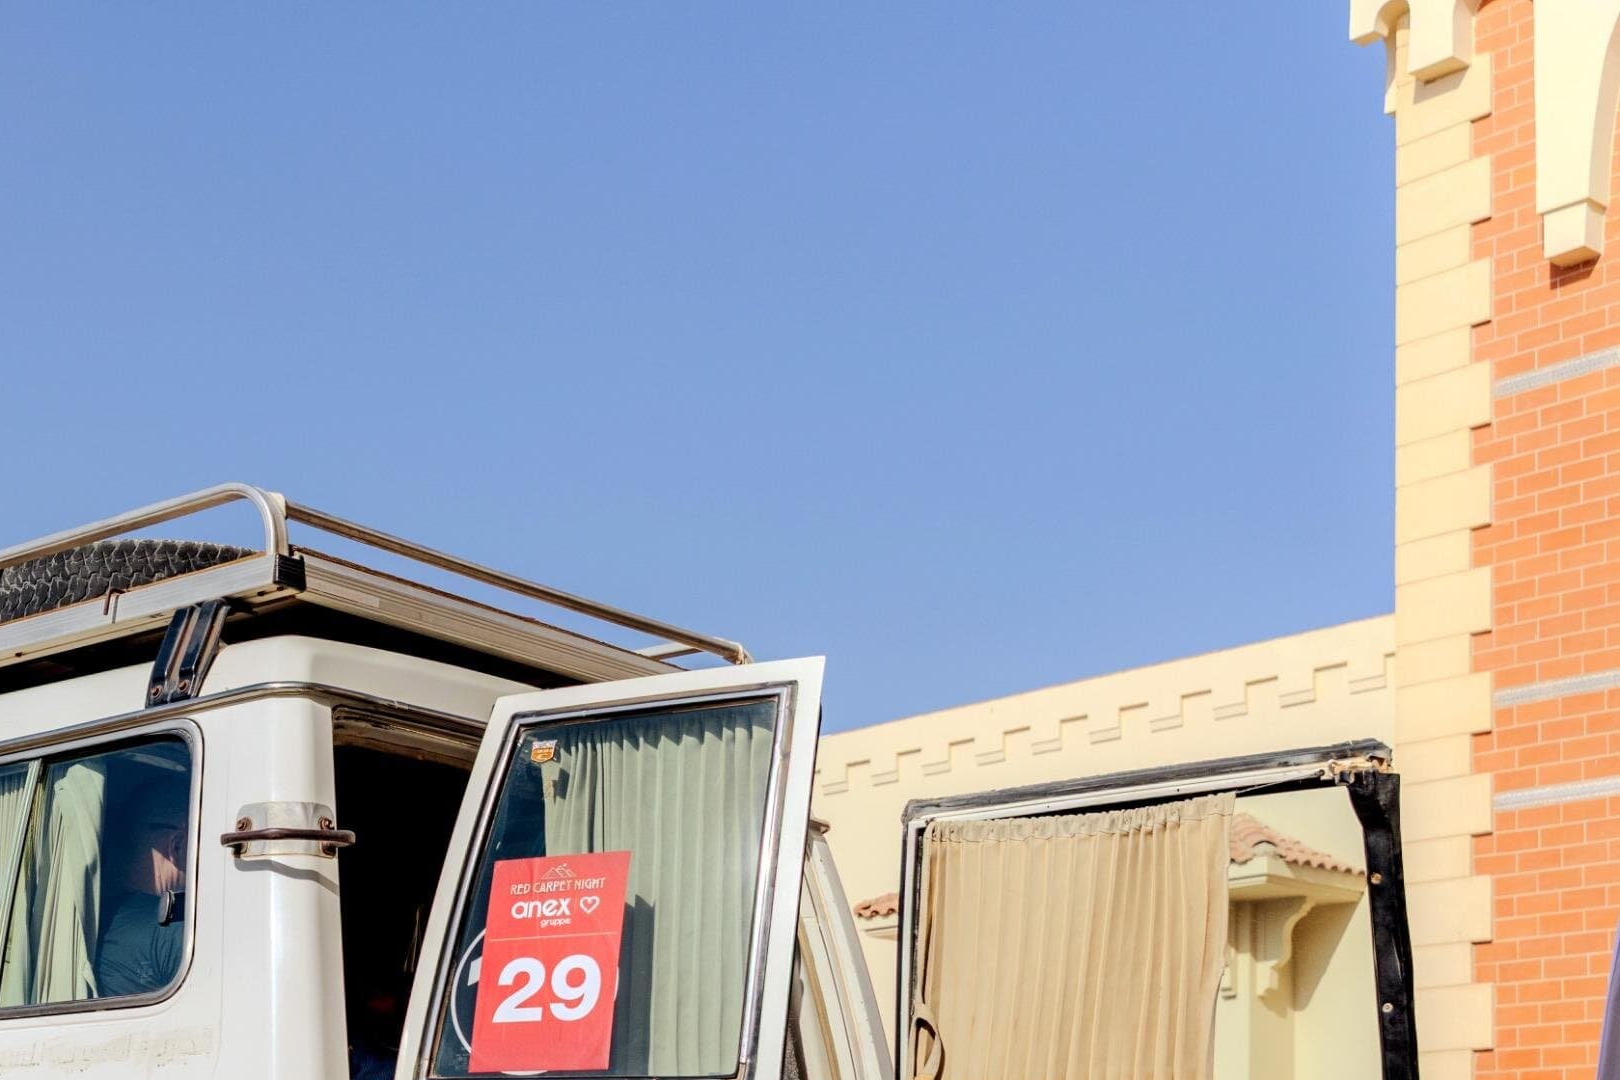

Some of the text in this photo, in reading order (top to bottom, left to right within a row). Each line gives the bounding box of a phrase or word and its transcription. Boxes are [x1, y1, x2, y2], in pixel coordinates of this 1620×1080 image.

[510, 876, 606, 895] RED CARPET NIGHT
[511, 898, 572, 919] anex
[539, 917, 572, 928] gruppe
[491, 954, 602, 1024] 29
